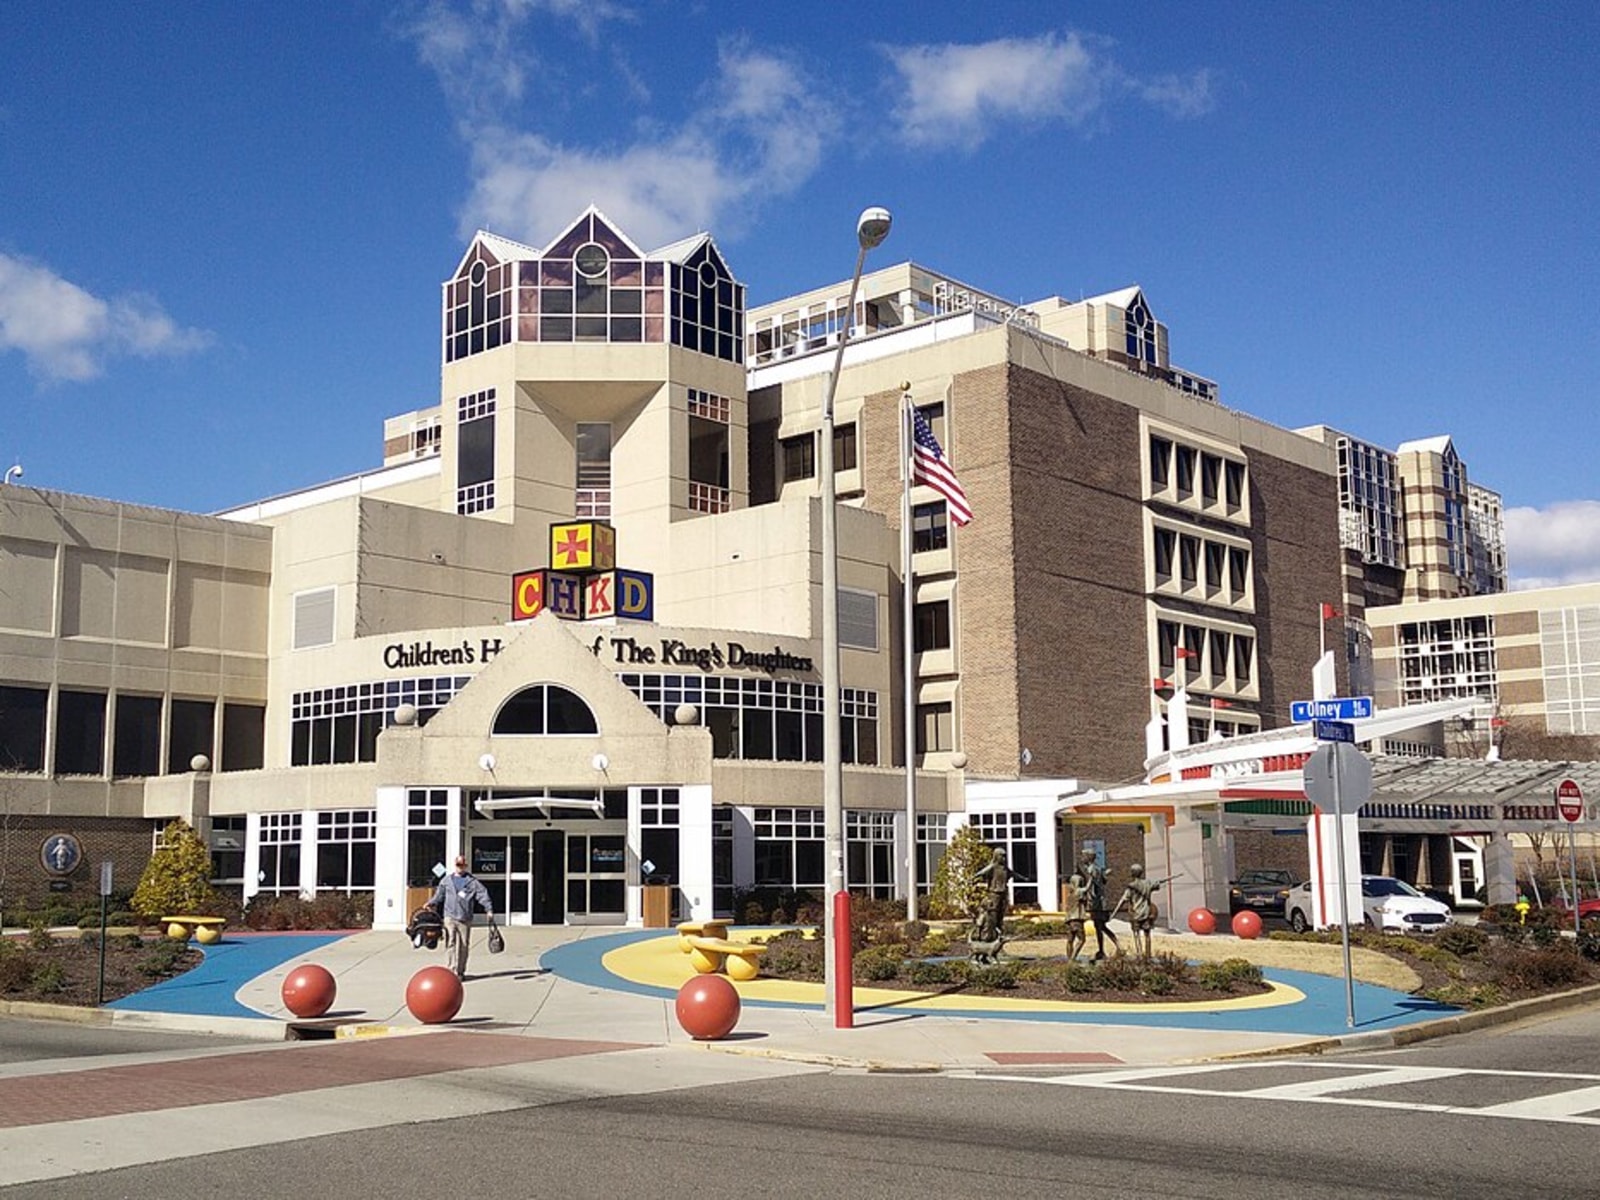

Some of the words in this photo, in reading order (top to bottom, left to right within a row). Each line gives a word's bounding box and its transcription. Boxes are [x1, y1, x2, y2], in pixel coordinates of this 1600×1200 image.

[518, 576, 648, 615] CHKD
[384, 641, 475, 669] Children's
[610, 637, 656, 664] The
[661, 639, 723, 671] King's
[727, 642, 813, 672] Daughters
[1307, 701, 1341, 721] Olney
[481, 863, 497, 872] 601
